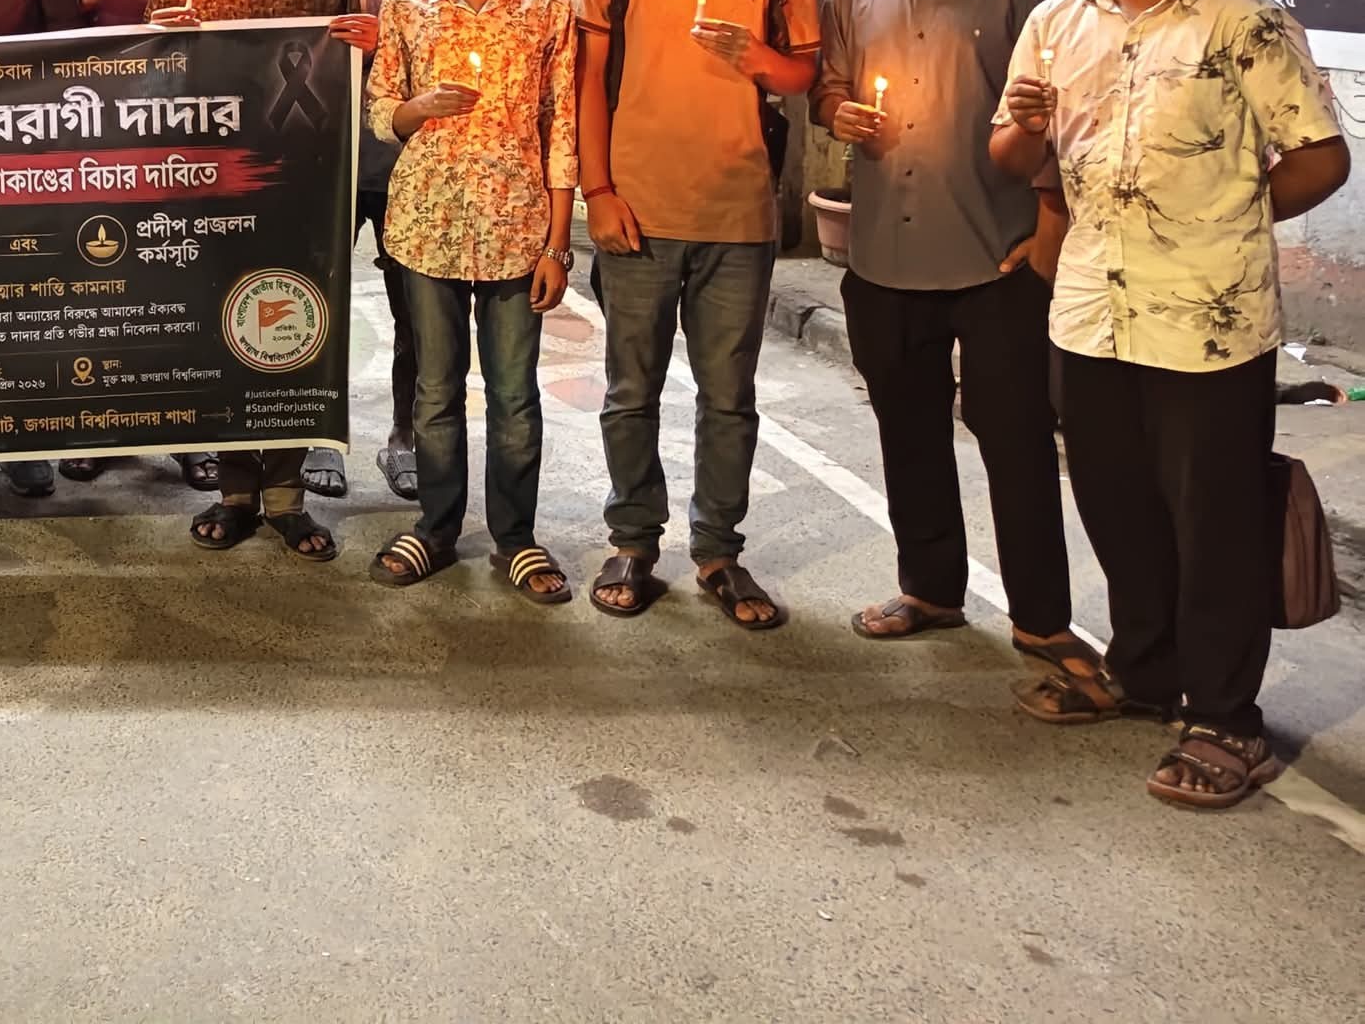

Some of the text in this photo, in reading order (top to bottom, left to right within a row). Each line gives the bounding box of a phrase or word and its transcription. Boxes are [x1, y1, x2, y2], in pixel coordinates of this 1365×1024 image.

[53, 51, 188, 79] ন্যায়বিচারের দাবি
[114, 95, 244, 137] দাদার
[79, 157, 138, 191] বিচার
[143, 154, 219, 189] দাবিতে
[136, 212, 257, 238] প্রদীপ প্রজ্বলন
[9, 237, 39, 252] এবং
[136, 239, 201, 268] কর্মসূচি
[30, 277, 66, 298] শান্তি
[69, 279, 127, 296] কামনায়
[15, 309, 61, 323] অন্যায়ের
[63, 305, 98, 320] বিরুদ্ধে
[101, 304, 145, 318] আমাদের
[147, 301, 187, 316] ঐক্যবদ্ধ
[10, 329, 41, 342] দাদার
[43, 325, 65, 341] প্রতি
[68, 324, 95, 340] গভীর
[98, 325, 120, 338] শ্রদ্ধা
[122, 321, 160, 337] নিবেদন
[18, 379, 46, 390] ২০২৬
[245, 388, 339, 400] #JusticeForBulletBairagi
[245, 402, 326, 414] #StandForJustice
[23, 414, 76, 433] জগন্নাথ
[80, 408, 161, 430] বিশ্ববিদ্যালয়
[165, 408, 197, 425] শাখা
[245, 416, 316, 429] #JnUStudents
